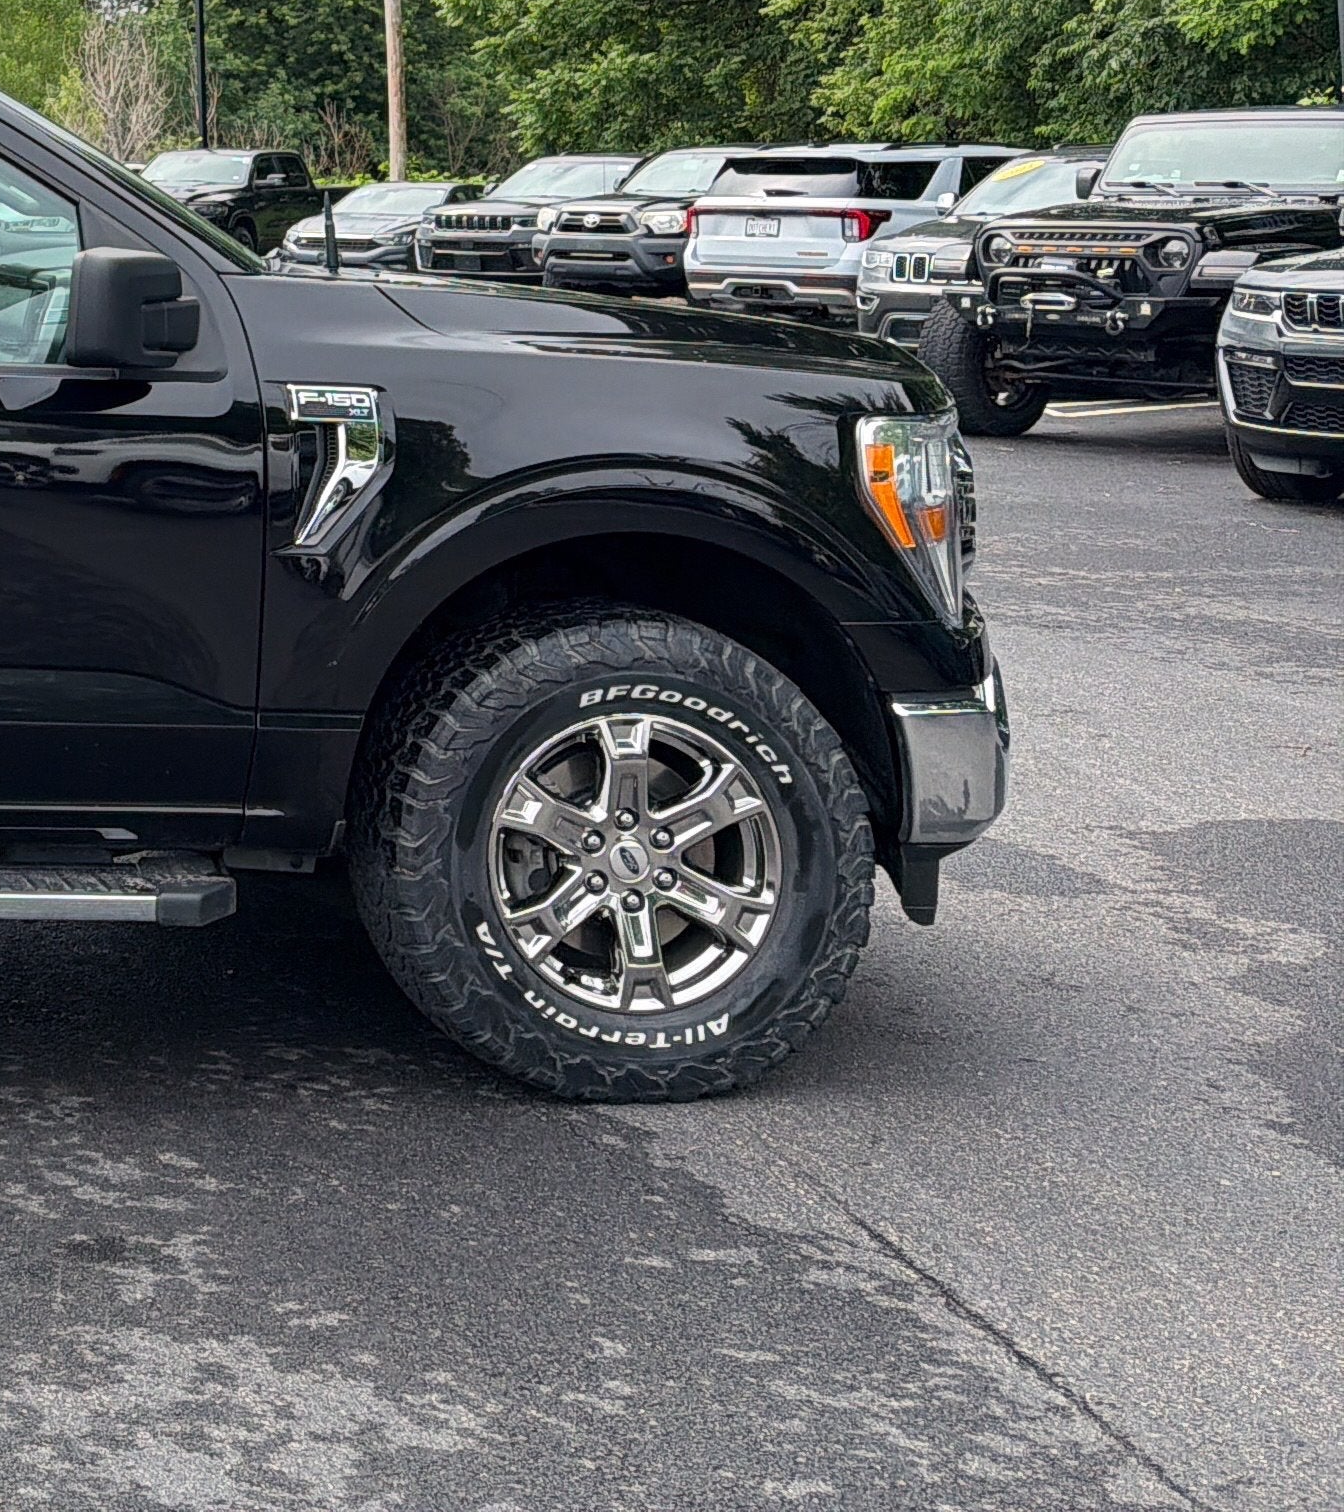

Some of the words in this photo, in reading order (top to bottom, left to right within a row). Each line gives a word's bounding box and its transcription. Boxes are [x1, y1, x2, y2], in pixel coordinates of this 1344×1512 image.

[297, 391, 371, 407] F-150
[348, 408, 370, 416] XLT
[578, 683, 794, 786] BFGoodrich
[475, 920, 516, 983] T/A
[523, 988, 731, 1050] All-Terrain
